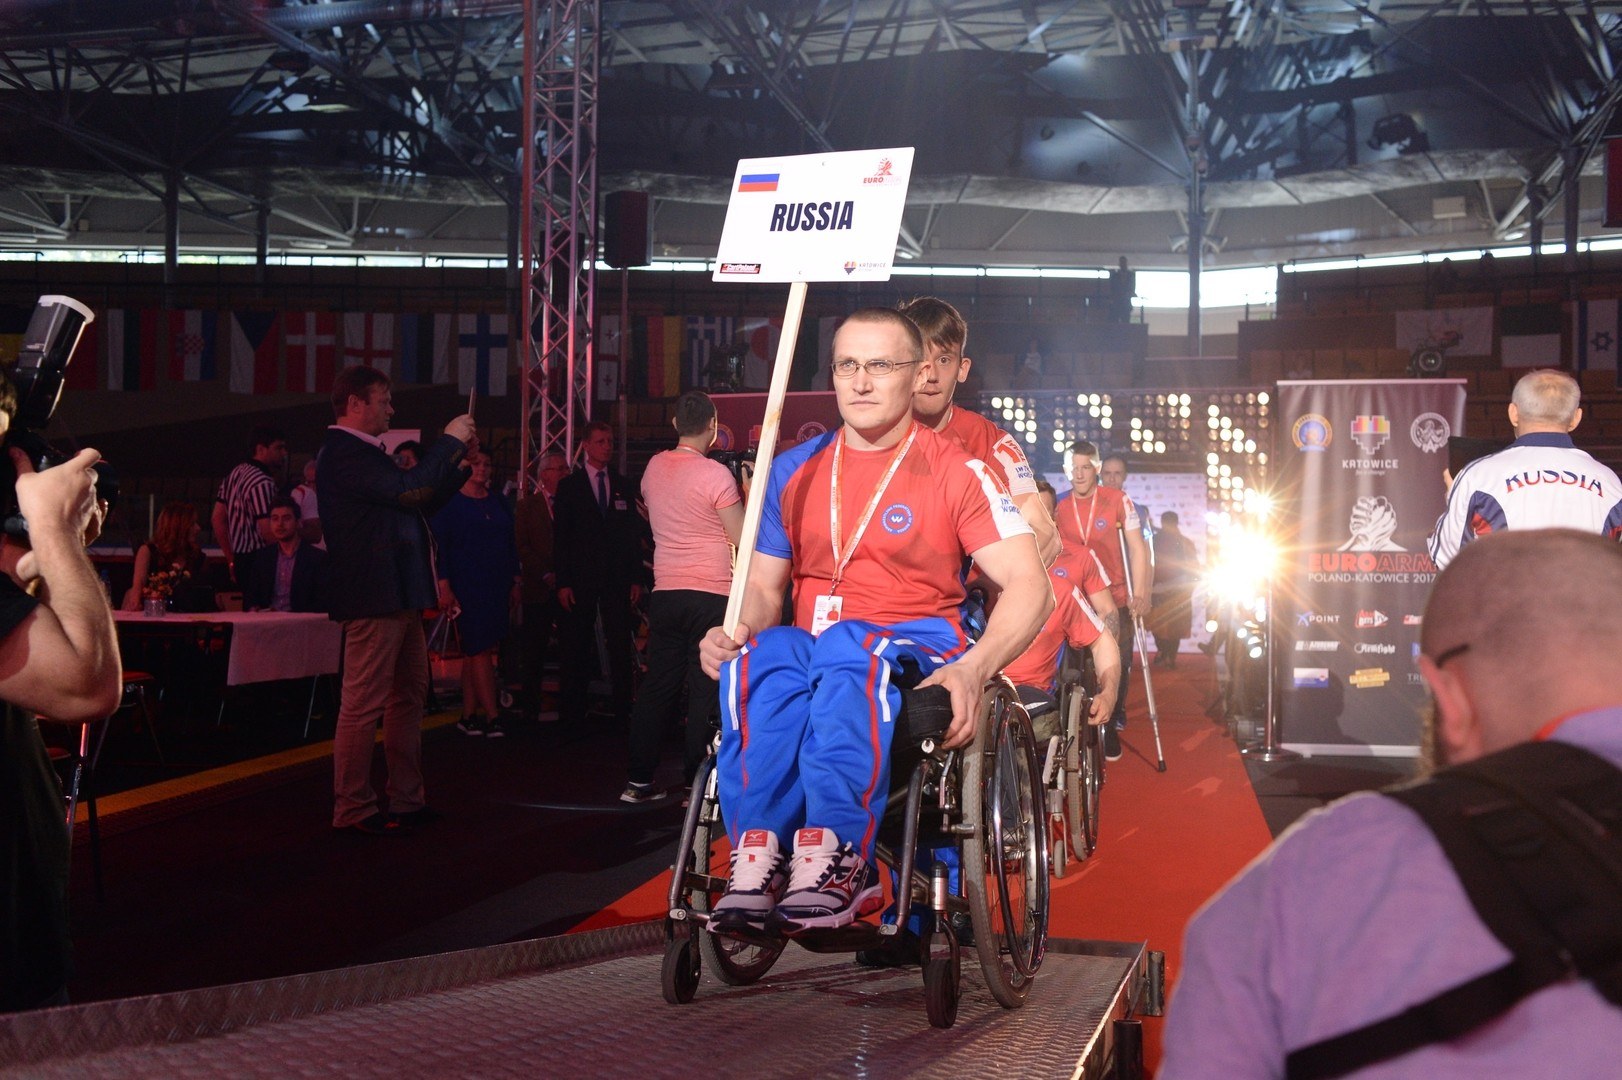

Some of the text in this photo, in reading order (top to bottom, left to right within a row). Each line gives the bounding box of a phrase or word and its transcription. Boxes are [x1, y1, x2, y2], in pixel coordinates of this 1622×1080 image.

[769, 200, 854, 232] RUSSIA
[1342, 459, 1399, 469] KATOWICE
[1505, 469, 1604, 498] RUSSIA
[1308, 572, 1437, 583] POLAND-KATOWICE 2017
